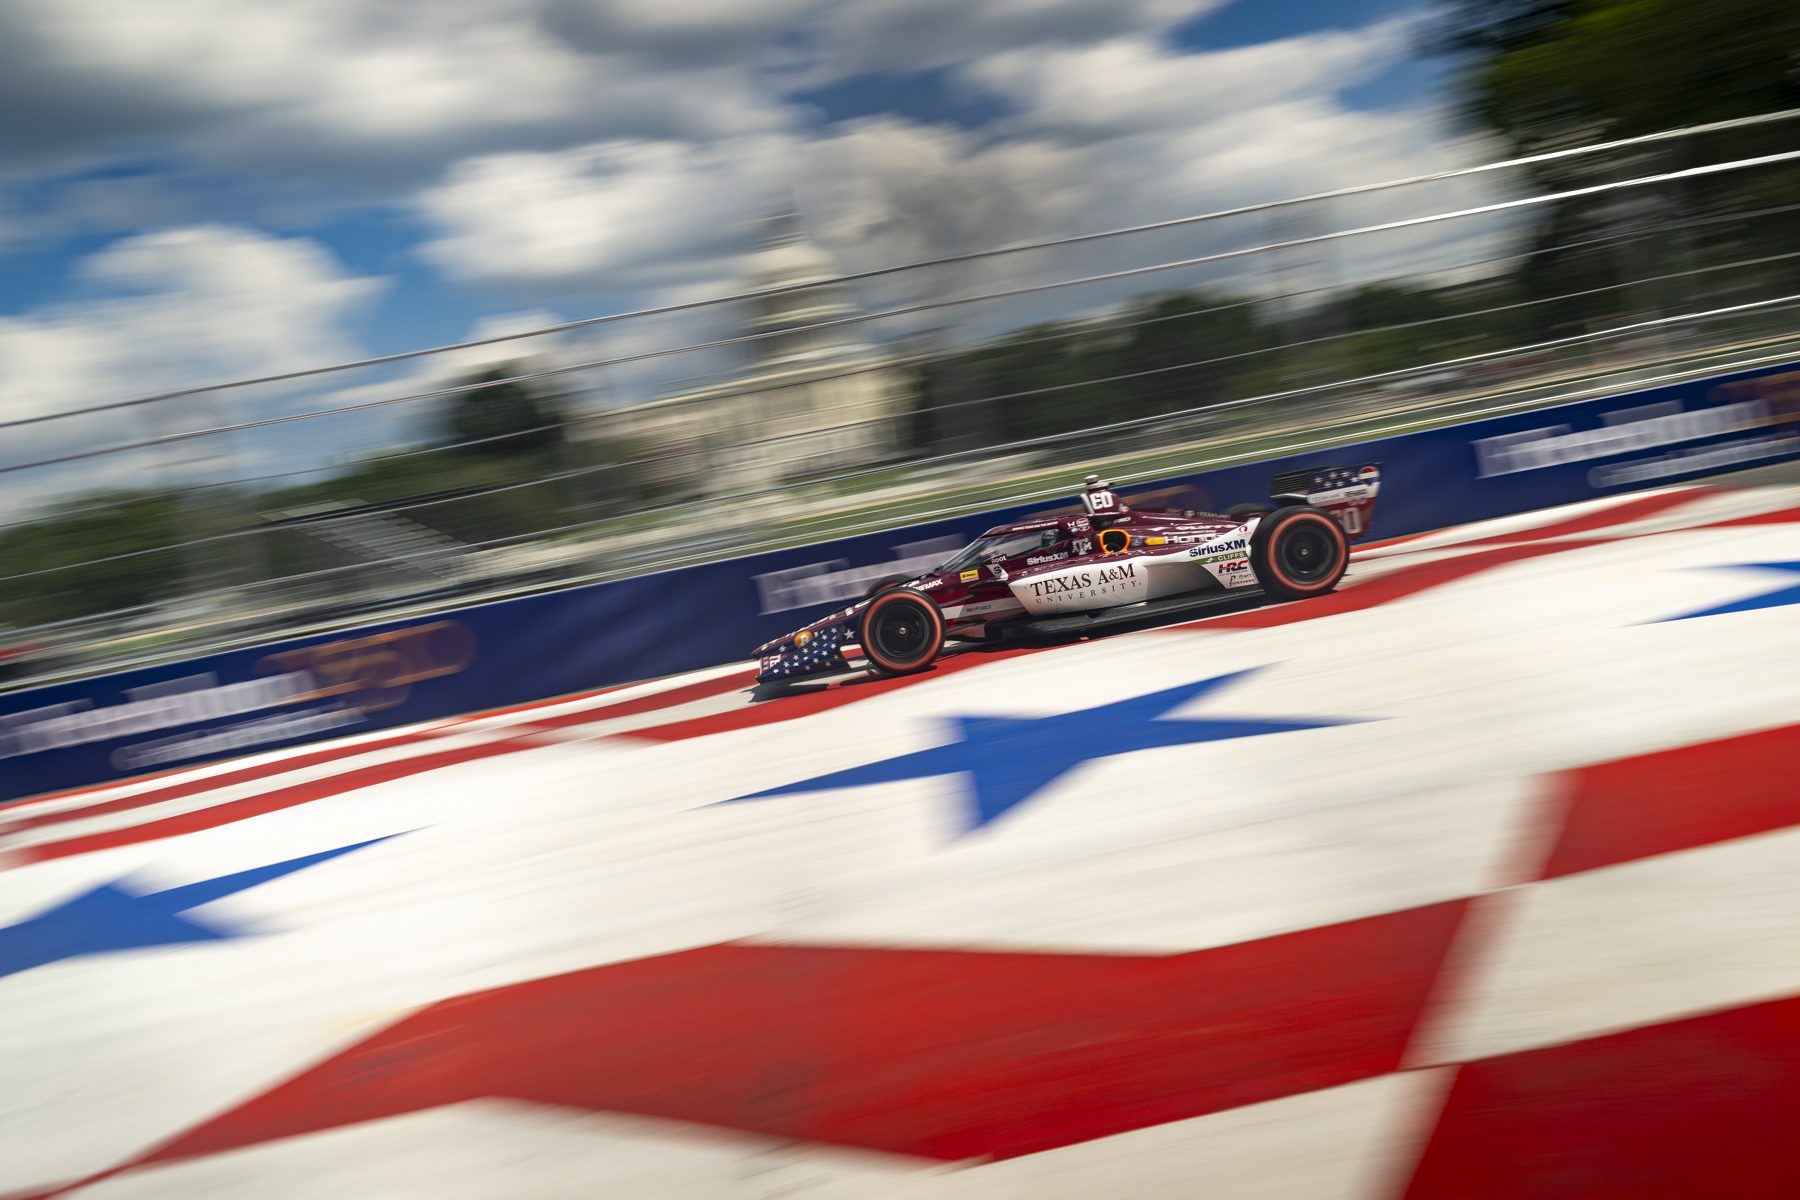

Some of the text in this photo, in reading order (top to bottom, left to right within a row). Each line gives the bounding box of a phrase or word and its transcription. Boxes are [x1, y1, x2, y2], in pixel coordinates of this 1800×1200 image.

[1090, 491, 1114, 510] 60
[1189, 539, 1246, 558] SiriusXM
[1217, 552, 1245, 561] CLIFFS
[1026, 551, 1069, 566] SiriusXM
[1218, 559, 1248, 574] HRC
[1030, 563, 1136, 597] TEXAS A&M
[1035, 580, 1138, 605] UNIVERSITY
